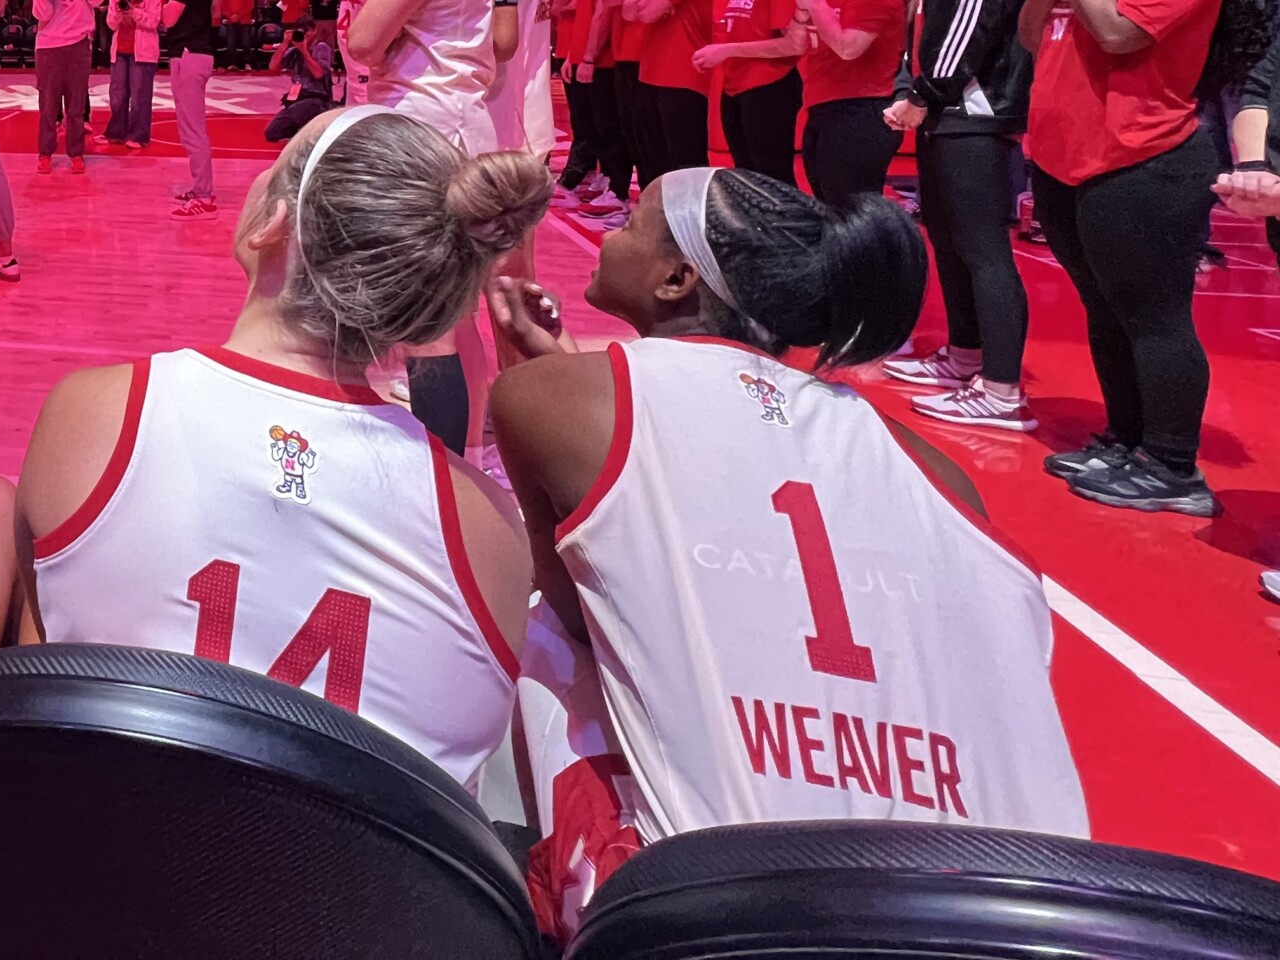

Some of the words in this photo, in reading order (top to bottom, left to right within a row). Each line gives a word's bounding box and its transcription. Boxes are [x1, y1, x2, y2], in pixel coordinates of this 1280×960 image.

[187, 558, 372, 715] 14
[693, 543, 922, 602] CATAULT
[771, 480, 877, 683] 1
[731, 696, 969, 819] WEAVER
